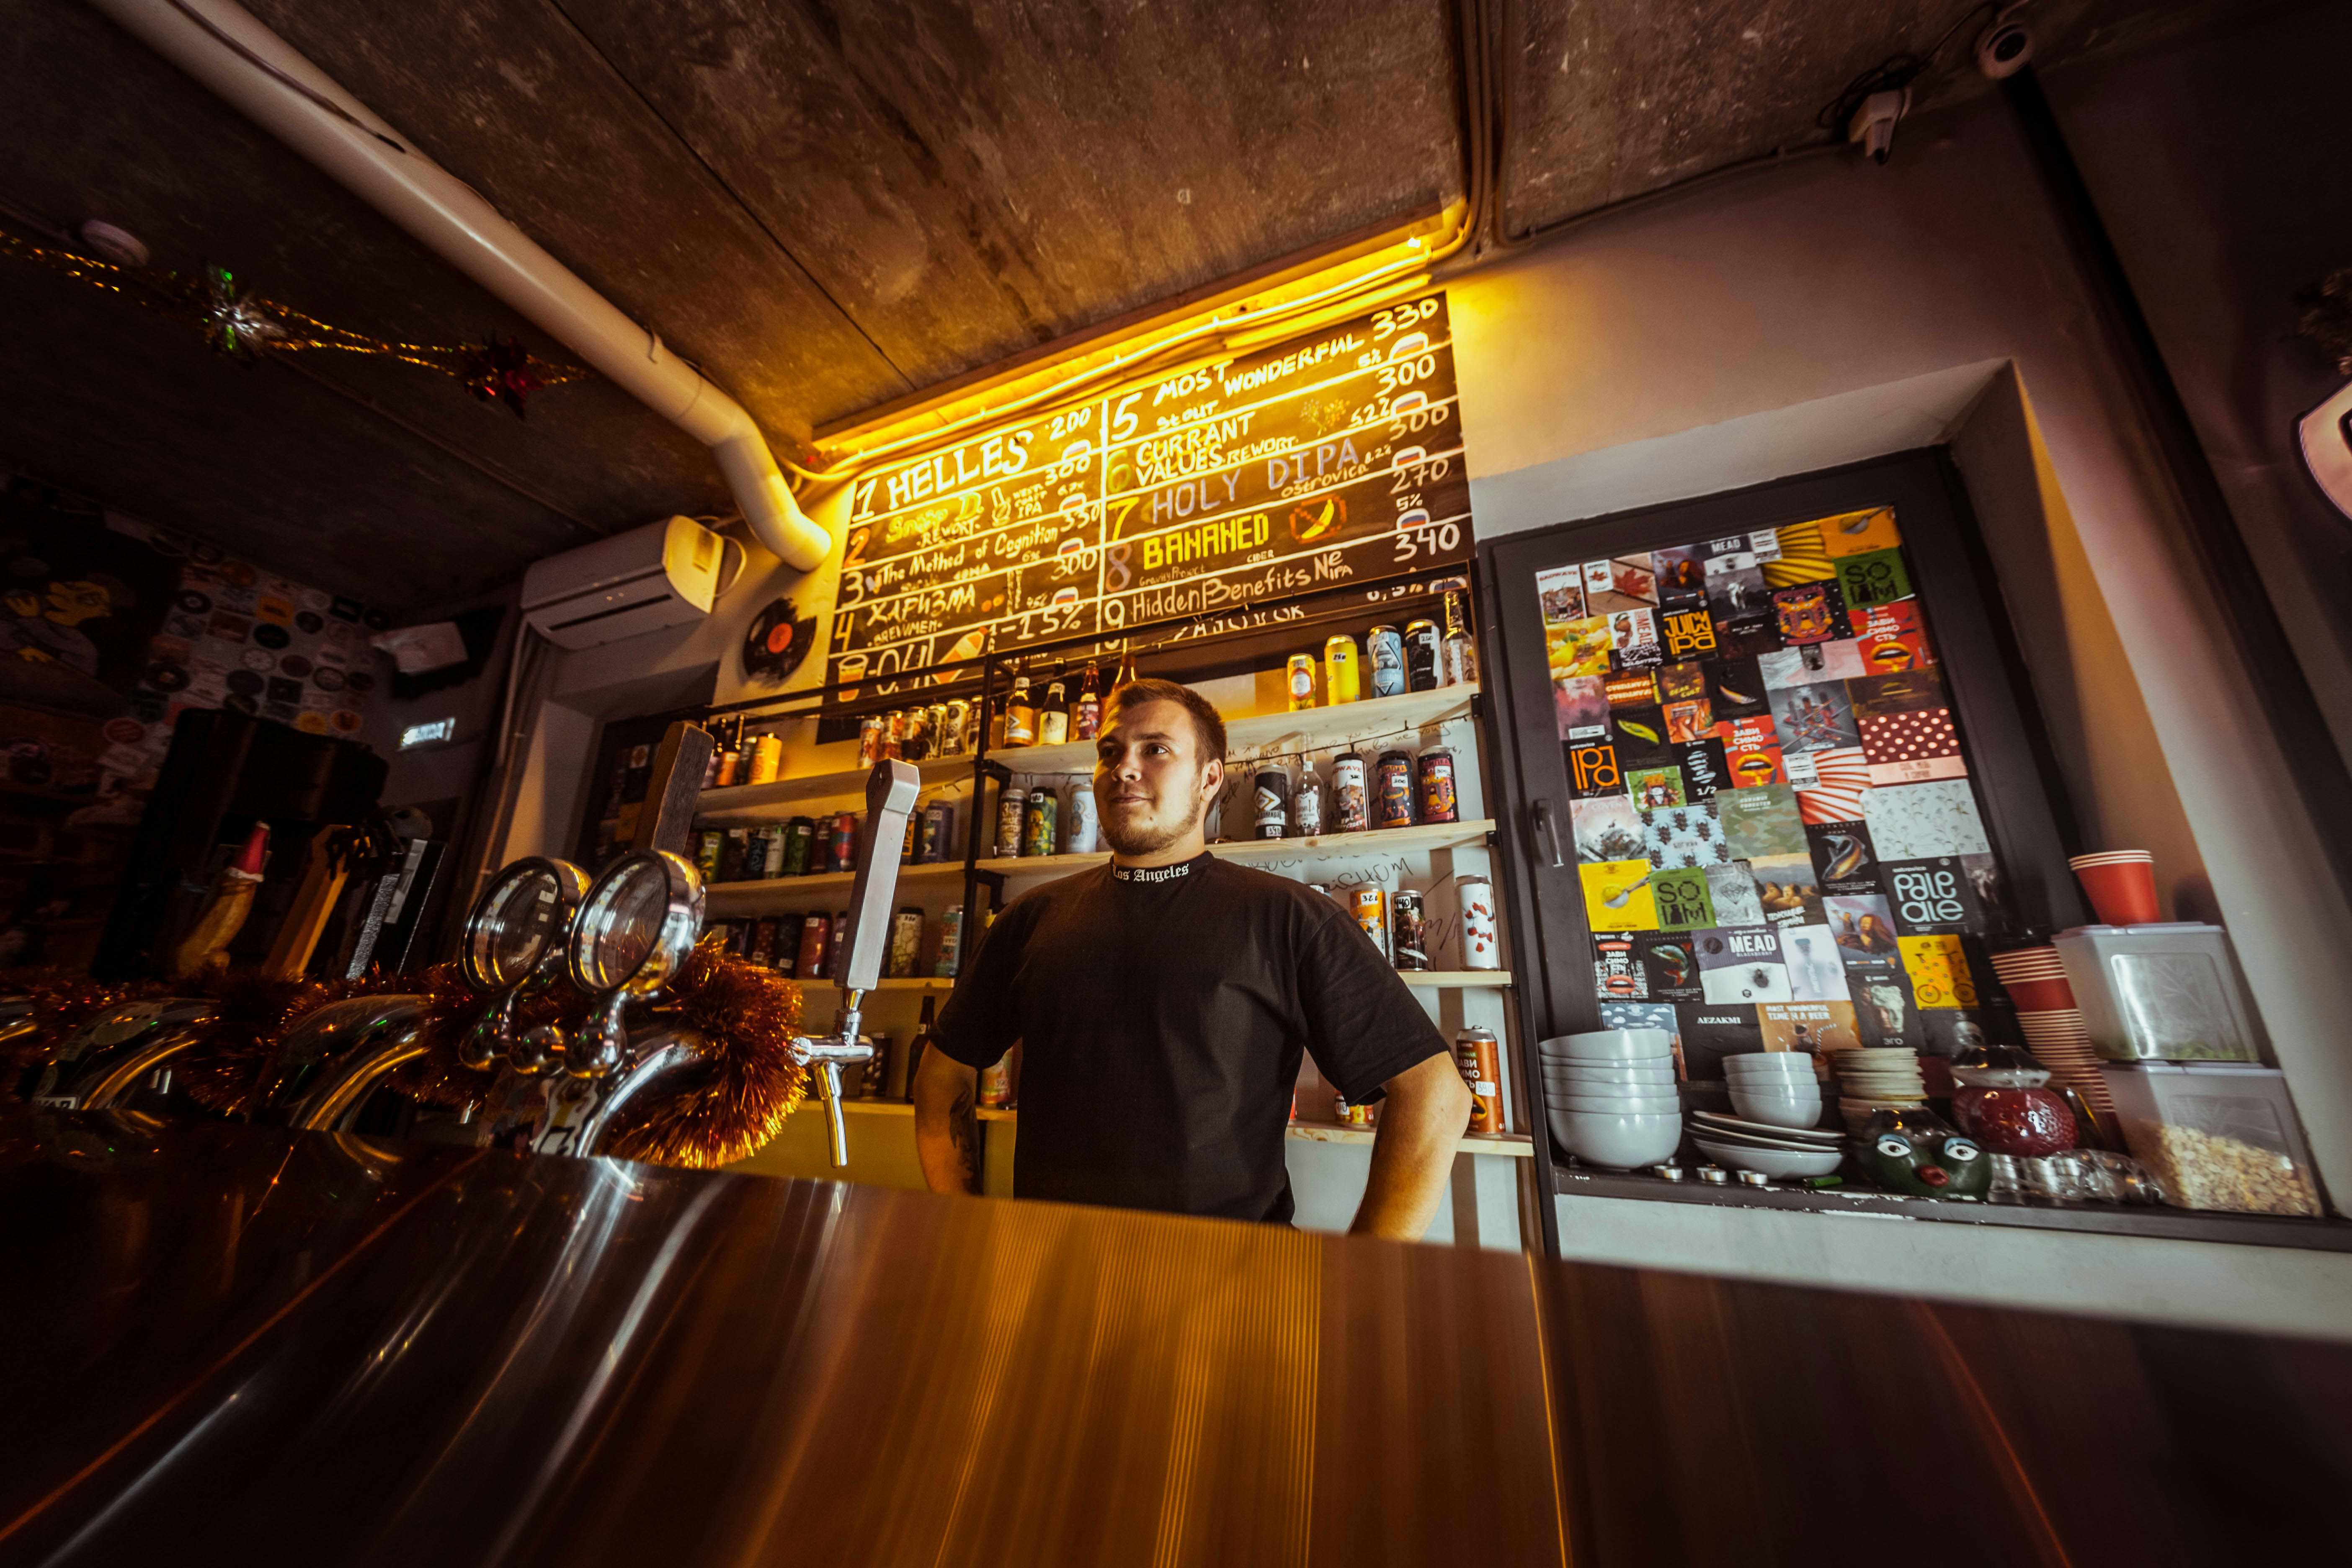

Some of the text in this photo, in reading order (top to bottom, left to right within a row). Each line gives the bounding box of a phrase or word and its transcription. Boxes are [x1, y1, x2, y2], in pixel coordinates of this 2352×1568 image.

[1371, 298, 1438, 341] 330
[1111, 333, 1365, 441] 5 MOST WONDERFUL
[1375, 354, 1435, 398] 300
[1389, 405, 1449, 441] 300
[1044, 454, 1091, 487] 300
[1107, 411, 1256, 493] 6 CURRANT
[1135, 443, 1223, 486] VALUES
[851, 478, 878, 522] 1
[887, 430, 1034, 511] HELLES
[1107, 438, 1359, 541] 7 HOLY DIPA
[1389, 459, 1448, 495] 270
[1018, 501, 1043, 518] IPA
[1396, 493, 1423, 512] 5%
[844, 528, 870, 567] 2
[1247, 549, 1274, 563] CIDER
[1394, 524, 1460, 562] 340
[842, 571, 864, 608] 3
[877, 562, 905, 585] The
[909, 543, 965, 575] Method
[975, 539, 989, 558] of
[994, 522, 1058, 559] Cognition
[1051, 549, 1097, 580] 300
[1106, 544, 1132, 593] 8
[1104, 599, 1125, 628] 9
[1132, 586, 1200, 622] Hidden
[1202, 567, 1310, 609] Benefits
[835, 613, 854, 651] 4
[1636, 618, 1653, 645] MEAD
[1663, 610, 1712, 638] JUICY
[1112, 864, 1189, 883] Los Angeles
[1728, 934, 1777, 953] MEAD
